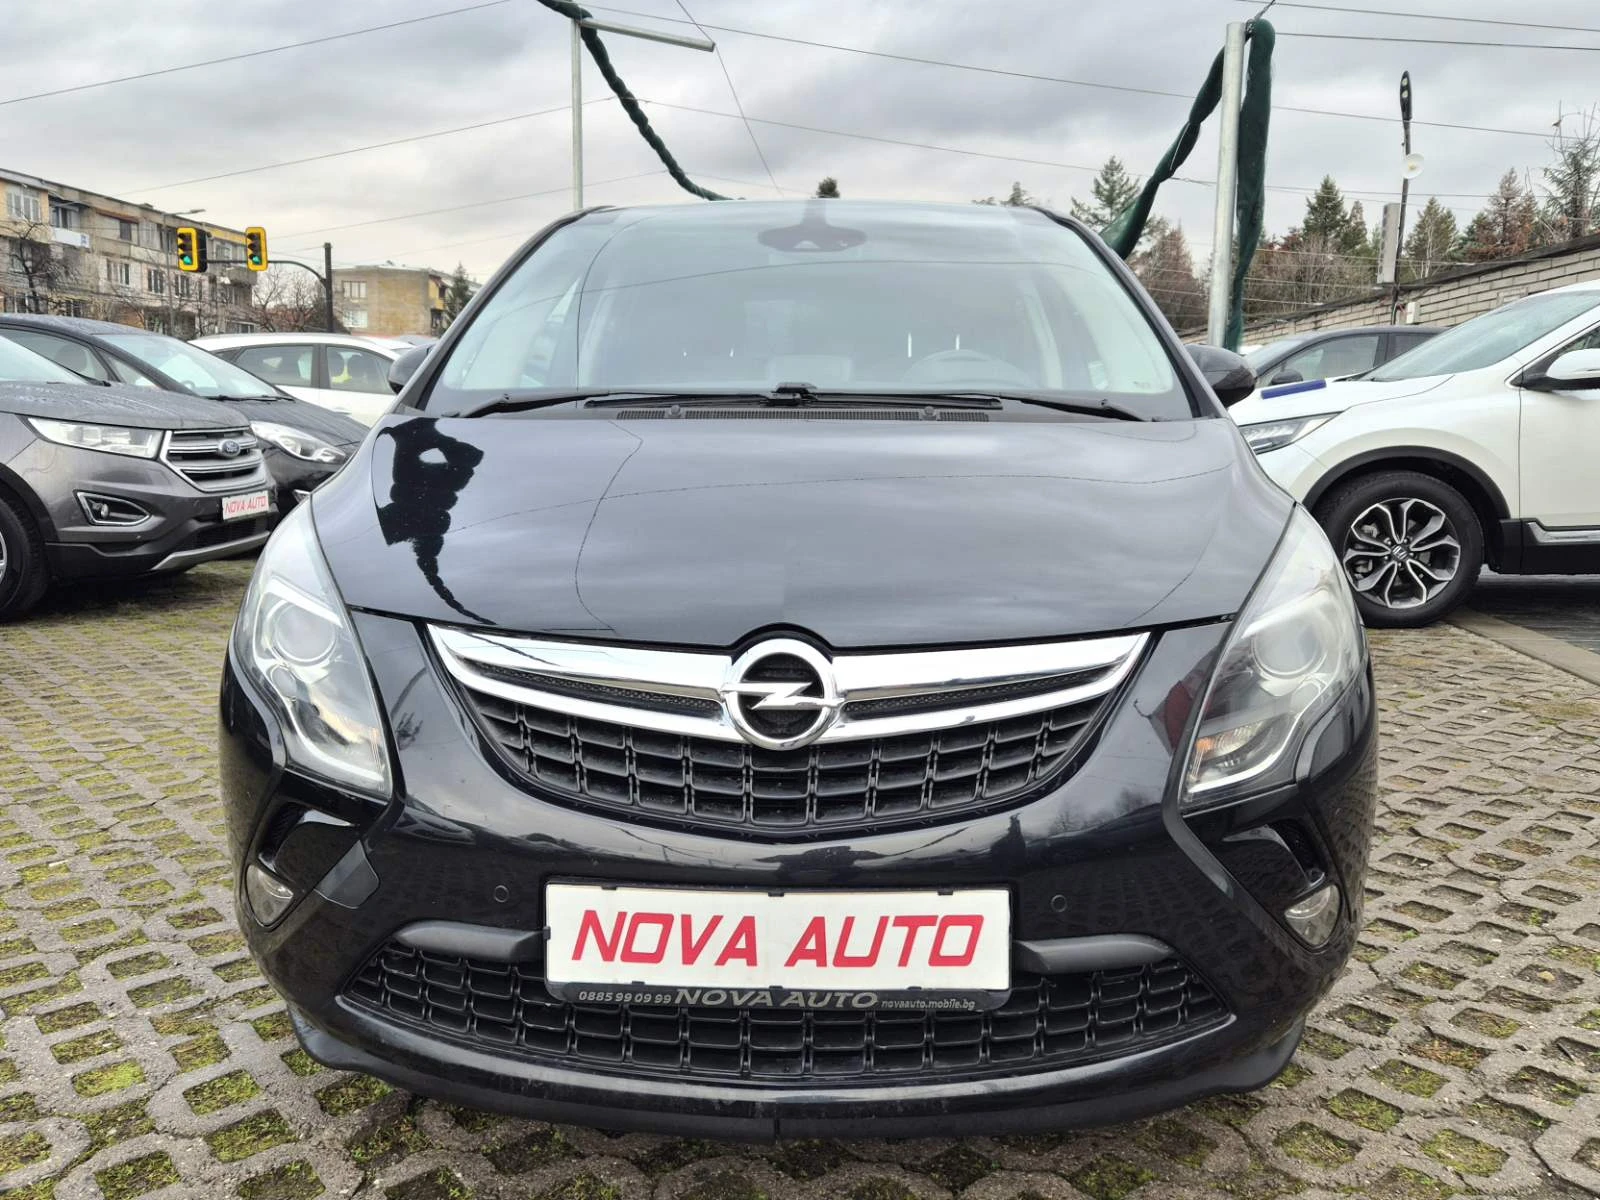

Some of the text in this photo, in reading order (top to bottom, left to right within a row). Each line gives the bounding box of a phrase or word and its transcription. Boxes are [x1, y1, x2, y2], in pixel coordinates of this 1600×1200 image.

[247, 495, 266, 509] AUTO
[572, 910, 984, 967] NOVA AUTO
[674, 988, 774, 1007] NOVA
[780, 991, 879, 1008] AUTO
[881, 999, 976, 1011] novaauto.mobile.bg
